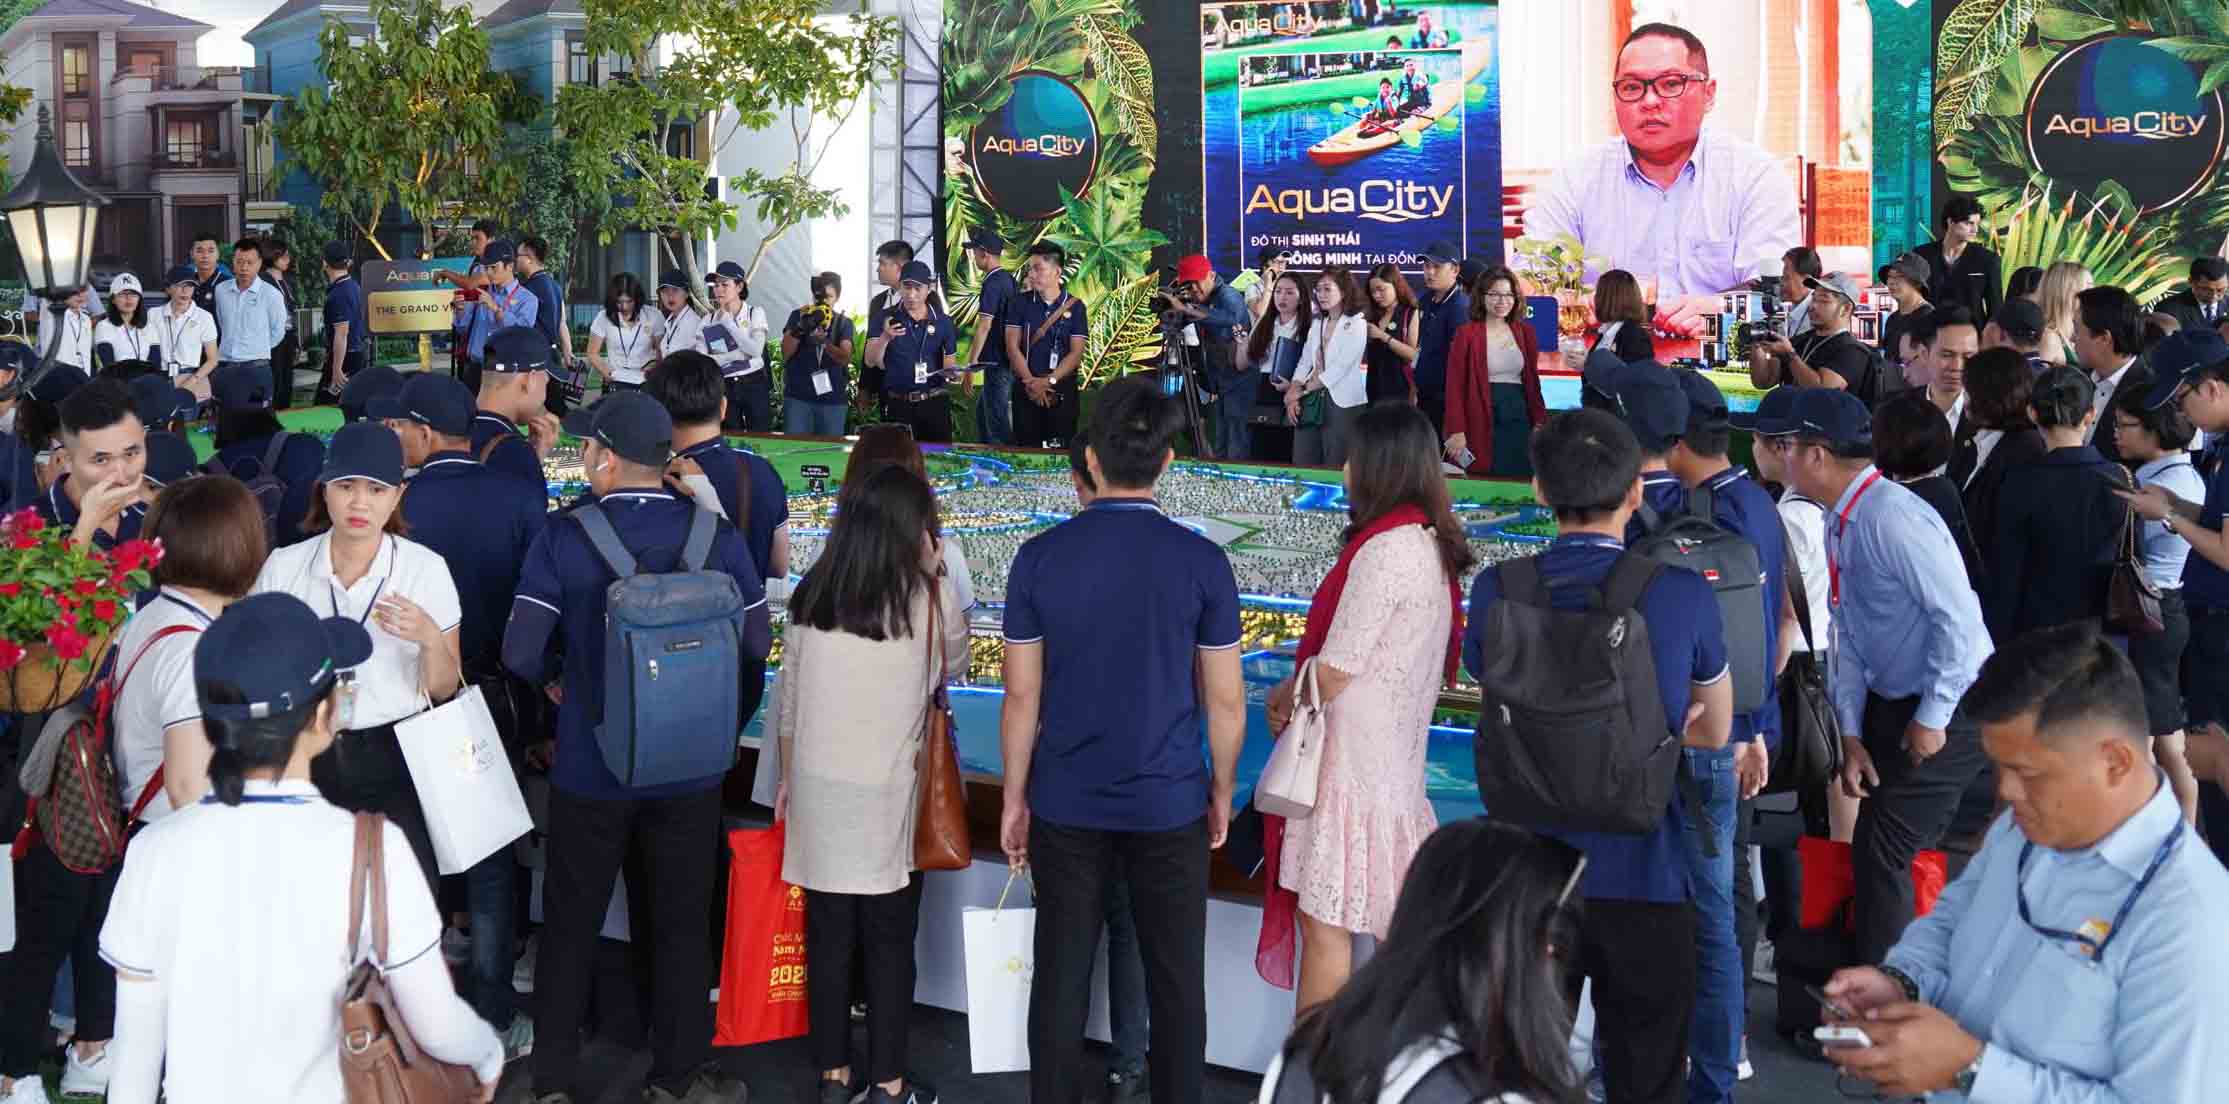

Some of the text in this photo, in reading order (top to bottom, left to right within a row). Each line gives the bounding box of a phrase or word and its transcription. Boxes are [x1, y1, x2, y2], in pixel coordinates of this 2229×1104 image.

[1292, 233, 1325, 246] SINH
[1326, 231, 1360, 246] THÁI
[1325, 252, 1361, 265] MINH
[376, 304, 397, 315] THE
[400, 303, 440, 314] GRAND
